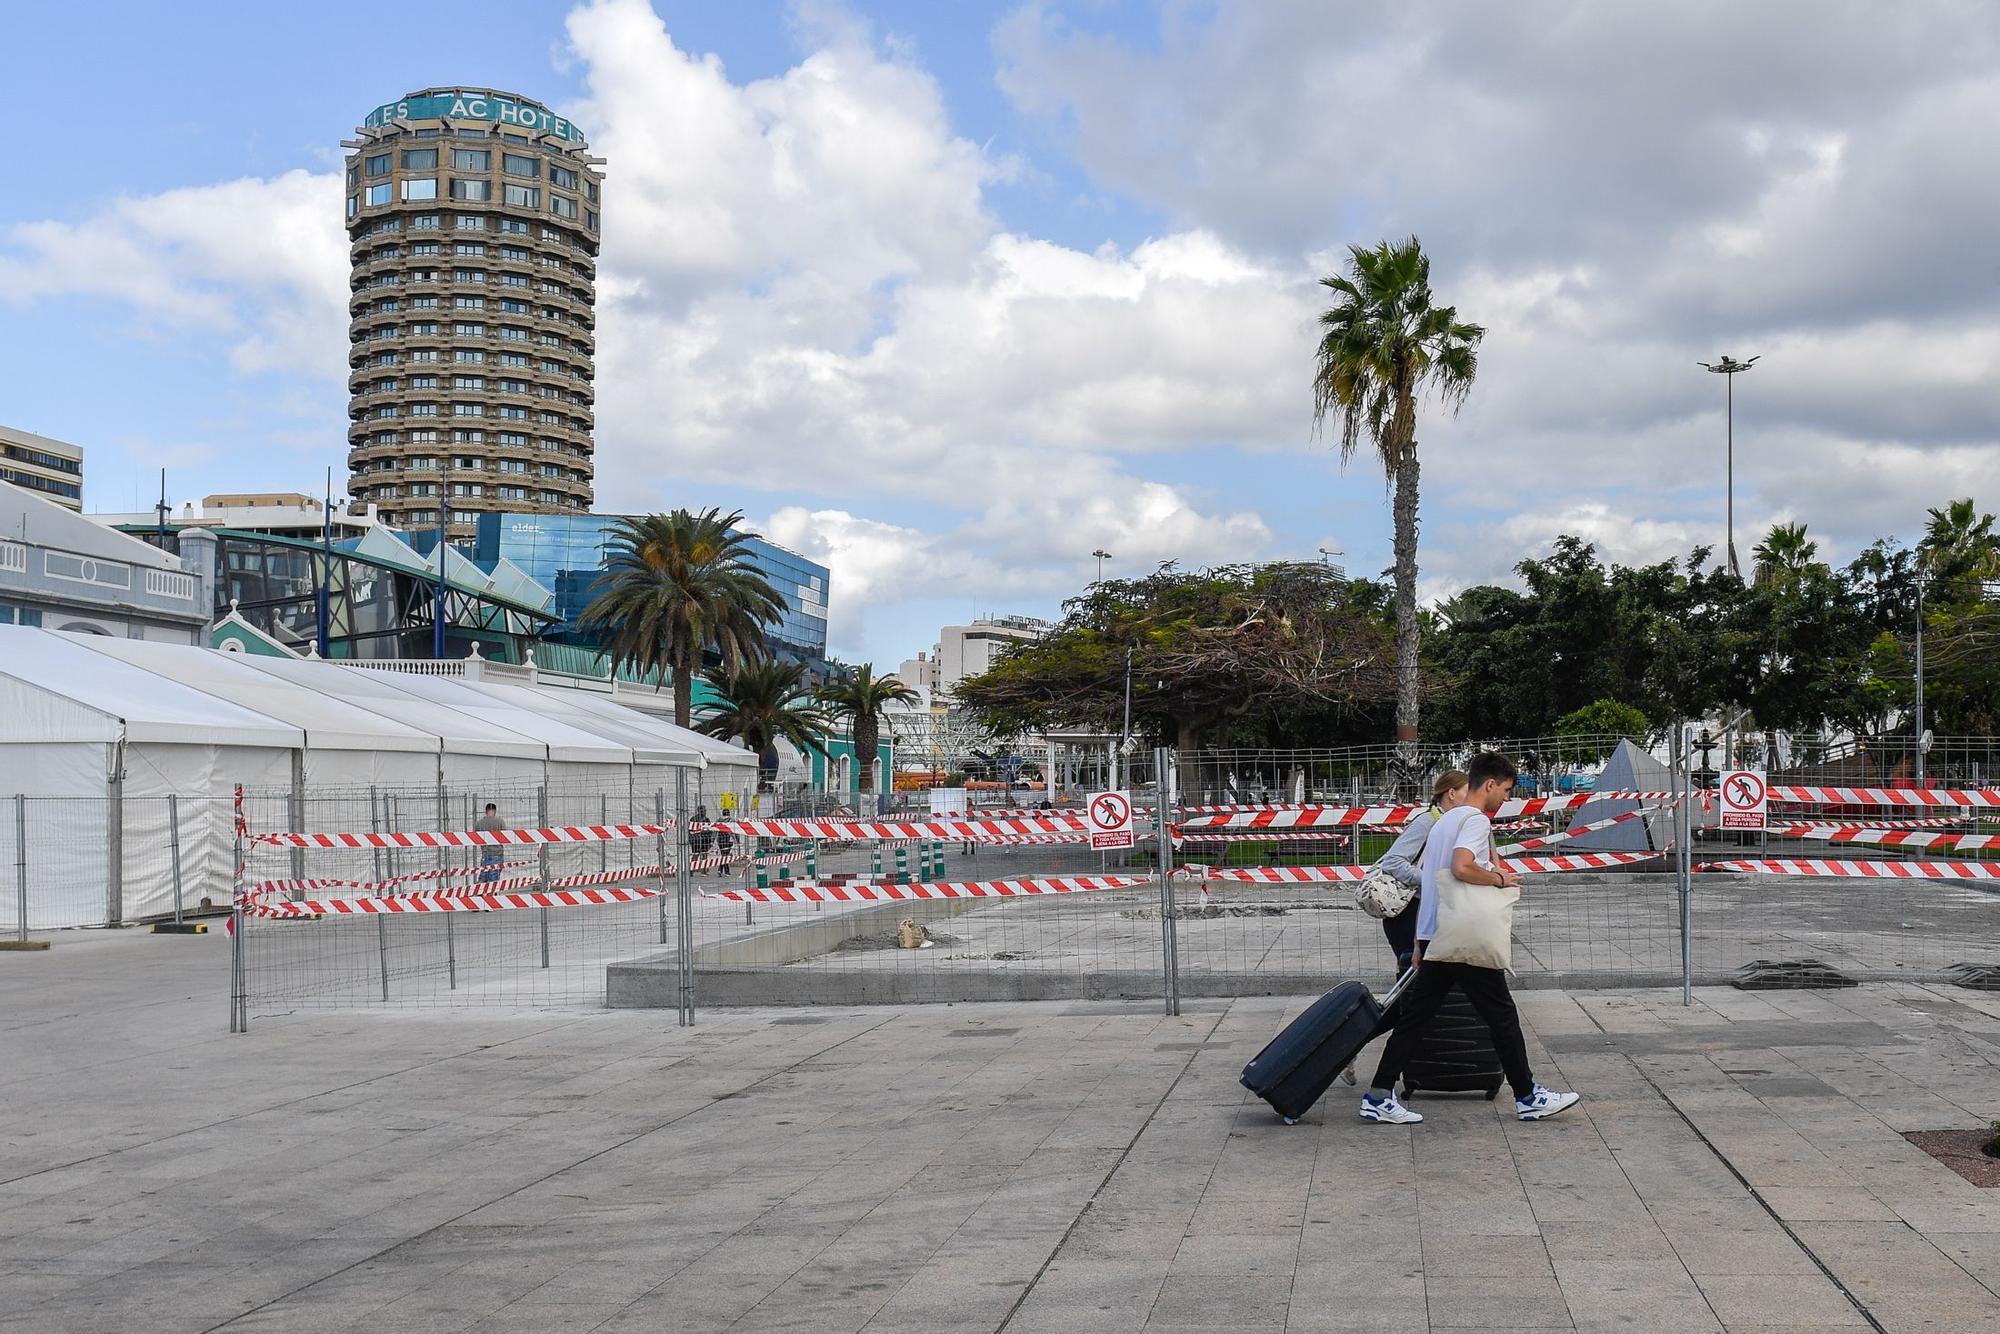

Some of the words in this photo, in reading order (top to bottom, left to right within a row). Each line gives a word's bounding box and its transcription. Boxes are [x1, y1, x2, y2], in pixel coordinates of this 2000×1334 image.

[449, 99, 487, 117] AC
[1537, 1097, 1548, 1105] N
[1384, 1102, 1395, 1111] N
